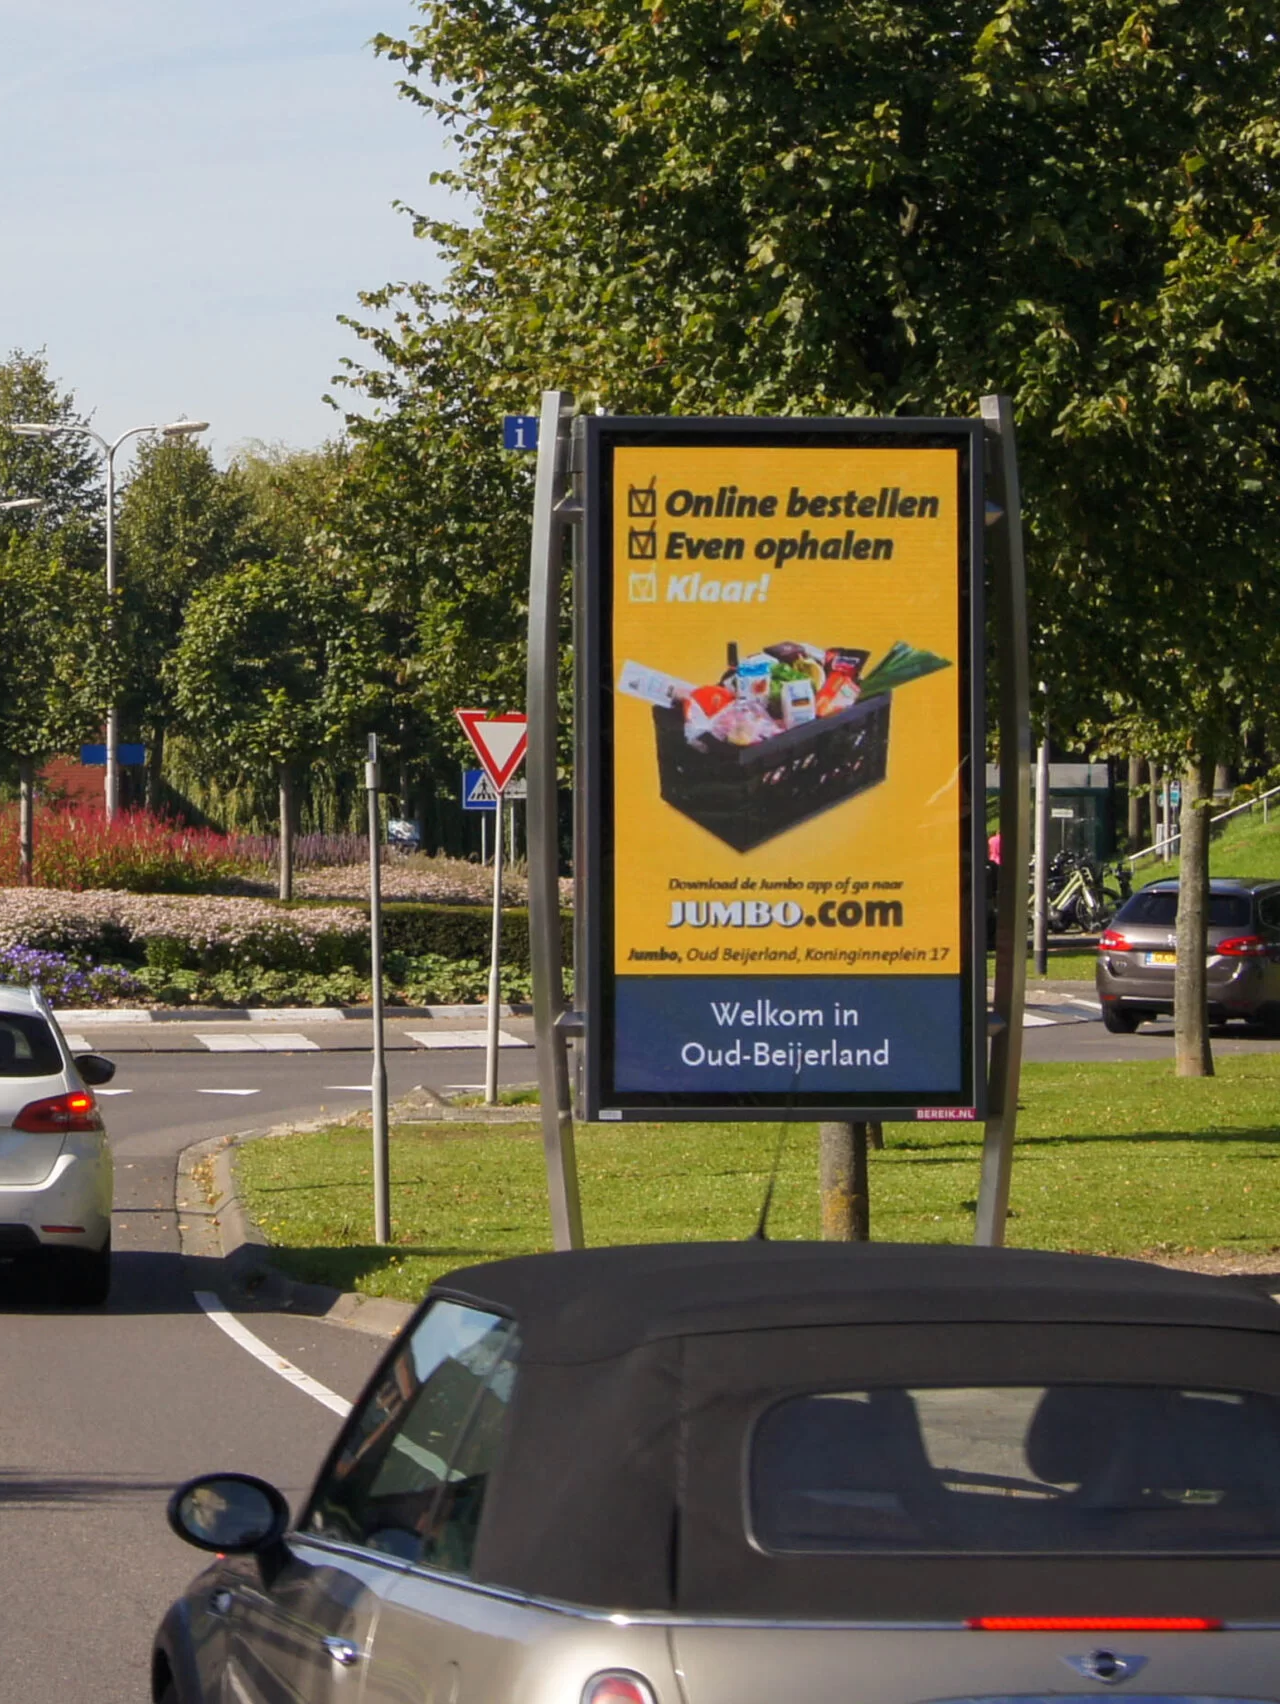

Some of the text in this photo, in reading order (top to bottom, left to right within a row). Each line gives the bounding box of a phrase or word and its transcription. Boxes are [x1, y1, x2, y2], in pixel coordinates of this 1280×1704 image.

[665, 486, 940, 518] Online bestellen
[665, 530, 894, 569] Even ophalen
[665, 573, 771, 603] Klaar!
[669, 877, 904, 895] Download de Jumbo app of ga naar
[667, 900, 904, 929] JUMBO.com
[628, 946, 950, 966] Jumbo, Oud Beijerland, Koninginneplein 17
[710, 1000, 859, 1027] Welkom in
[681, 1039, 890, 1074] Oud-Beijerland
[917, 1110, 975, 1119] BEREIK.NL
